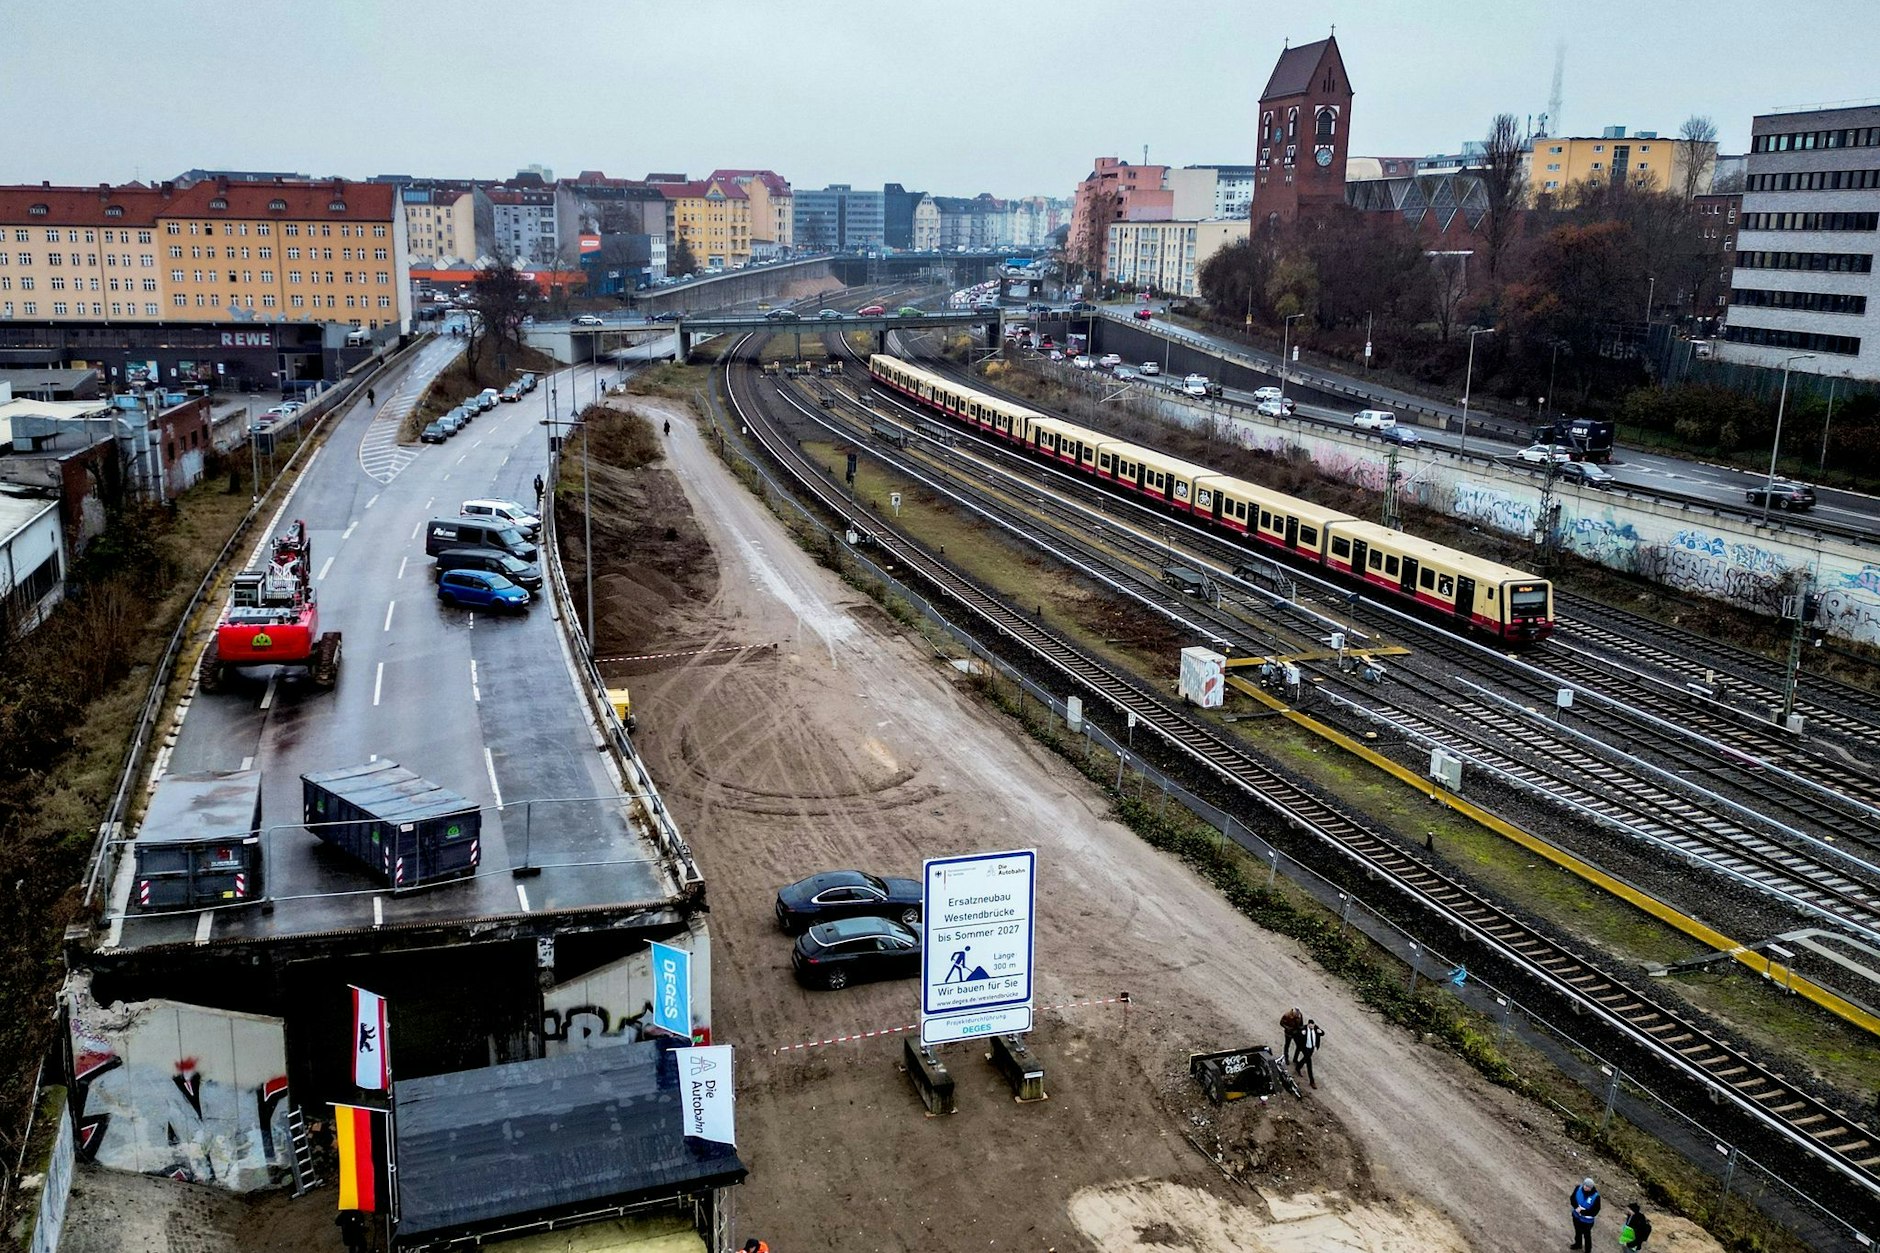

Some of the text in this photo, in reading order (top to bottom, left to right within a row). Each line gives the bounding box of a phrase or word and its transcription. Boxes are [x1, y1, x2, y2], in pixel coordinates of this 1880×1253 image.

[221, 332, 271, 346] REWE
[998, 868, 1026, 876] Autobahn
[948, 893, 1011, 907] Ersatzneubau
[944, 908, 1015, 922] Westendbrücke
[938, 924, 1020, 942] bis Sommer 2027
[993, 962, 1007, 971] 300
[663, 959, 679, 1020] DEGES
[938, 979, 1019, 996] Wir bauen für Sie
[946, 1014, 1007, 1026] Projektdurchführung
[962, 1024, 992, 1034] DEGES
[705, 1080, 716, 1099] Die
[691, 1081, 704, 1133] Autobahn
